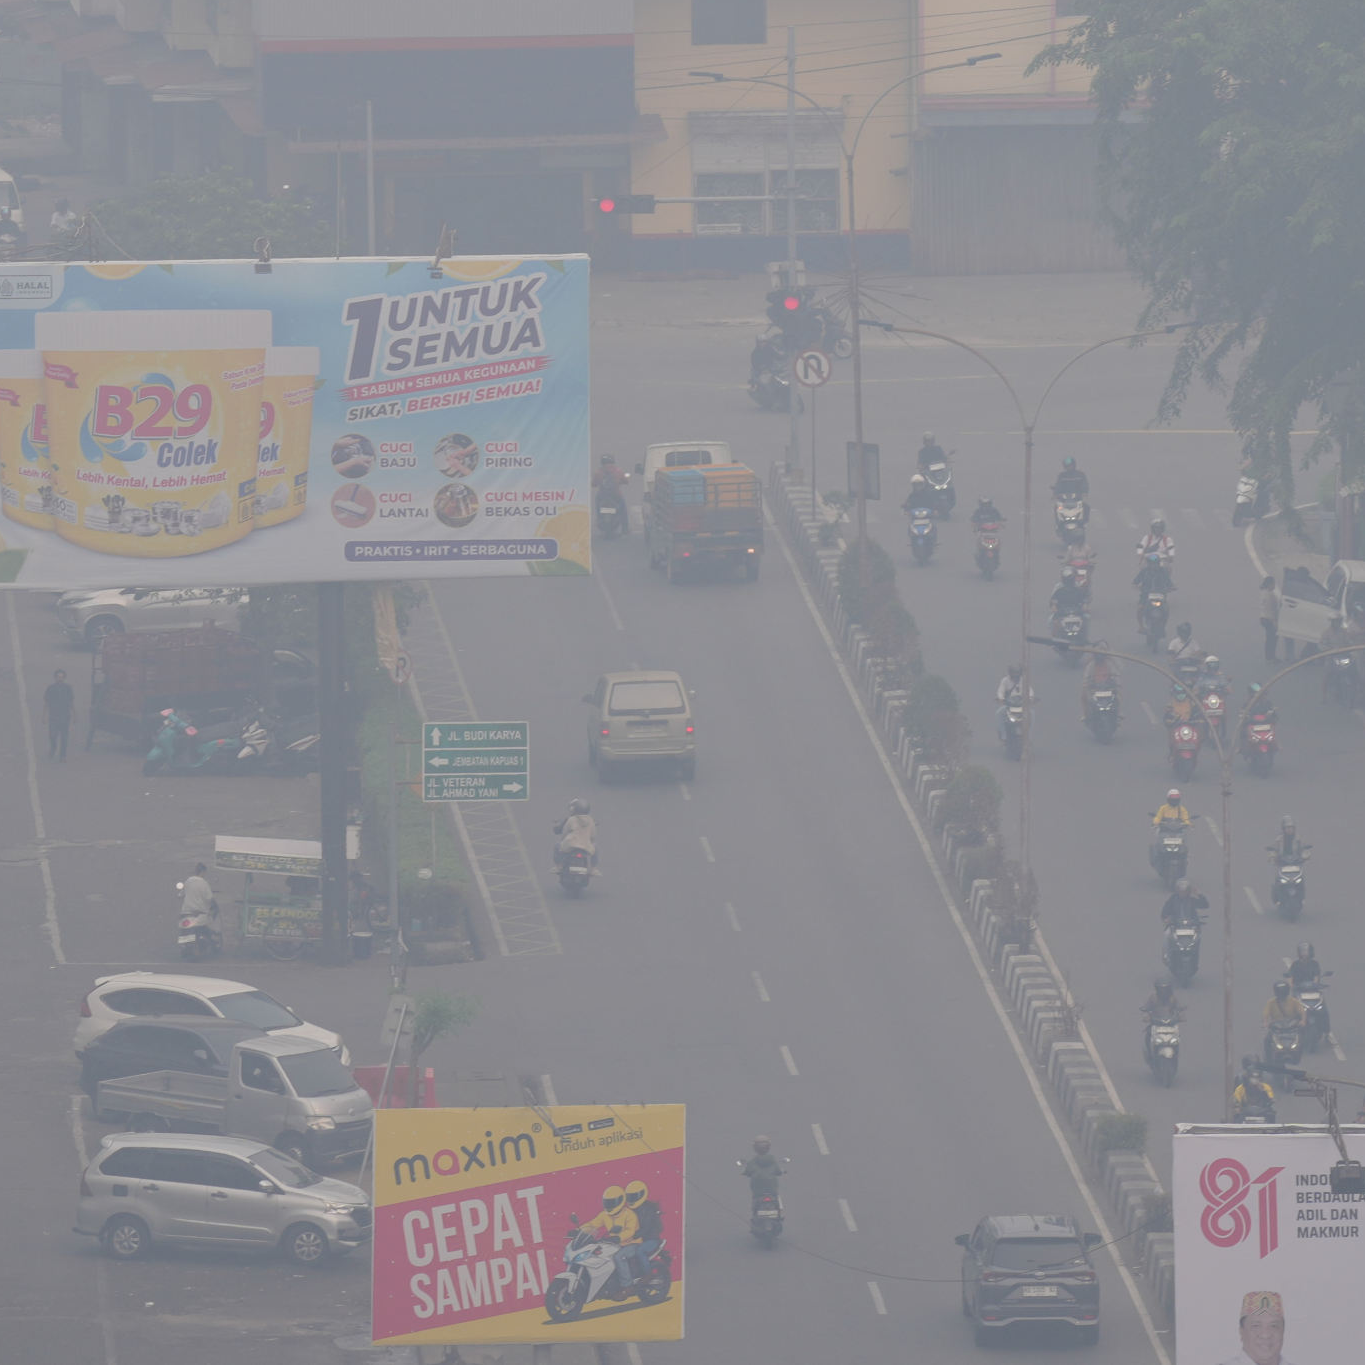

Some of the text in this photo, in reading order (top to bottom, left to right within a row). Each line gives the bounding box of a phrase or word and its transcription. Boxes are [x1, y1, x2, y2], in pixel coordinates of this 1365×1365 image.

[16, 282, 50, 290] HALAL
[346, 276, 542, 381] 1 UNTUK
[385, 317, 541, 372] SEMUA
[360, 380, 406, 398] SABUN
[415, 372, 461, 389] SEMUA
[464, 359, 536, 381] KEGUNAAN
[347, 379, 542, 422] SIKAT, BERSIH SEMUA!
[91, 384, 213, 441] B29
[157, 438, 219, 468] Colek
[379, 442, 413, 454] CUCI
[485, 442, 518, 453] CUCI
[379, 457, 417, 468] BAJU
[485, 457, 533, 468] PIRING
[76, 469, 228, 489] Lebih Kental, Lebih Hemat
[378, 493, 413, 504] CUCI
[485, 491, 517, 503] CUCI
[522, 490, 565, 502] MESIN
[379, 507, 429, 518] LANTAI
[485, 505, 557, 517] BEKAS OLI
[354, 544, 547, 557] PRAKTIS IRIT SERBAGUNA
[447, 730, 522, 741] JL. BUDI KARYA
[452, 755, 489, 767] JEMBATAN
[490, 755, 519, 766] KAPUAS
[442, 777, 486, 787] VETERAN
[442, 788, 475, 798] AHMAD
[477, 787, 499, 797] YANI
[554, 1137, 595, 1155] Unduh
[598, 1127, 644, 1148] aplikasi
[393, 1130, 537, 1186] maxim
[1199, 1157, 1287, 1260] 81
[1296, 1208, 1359, 1221] ADIL DAN
[402, 1185, 546, 1268] CEPAT
[1296, 1226, 1359, 1239] MAKMUR
[409, 1248, 550, 1320] SAMPAI
